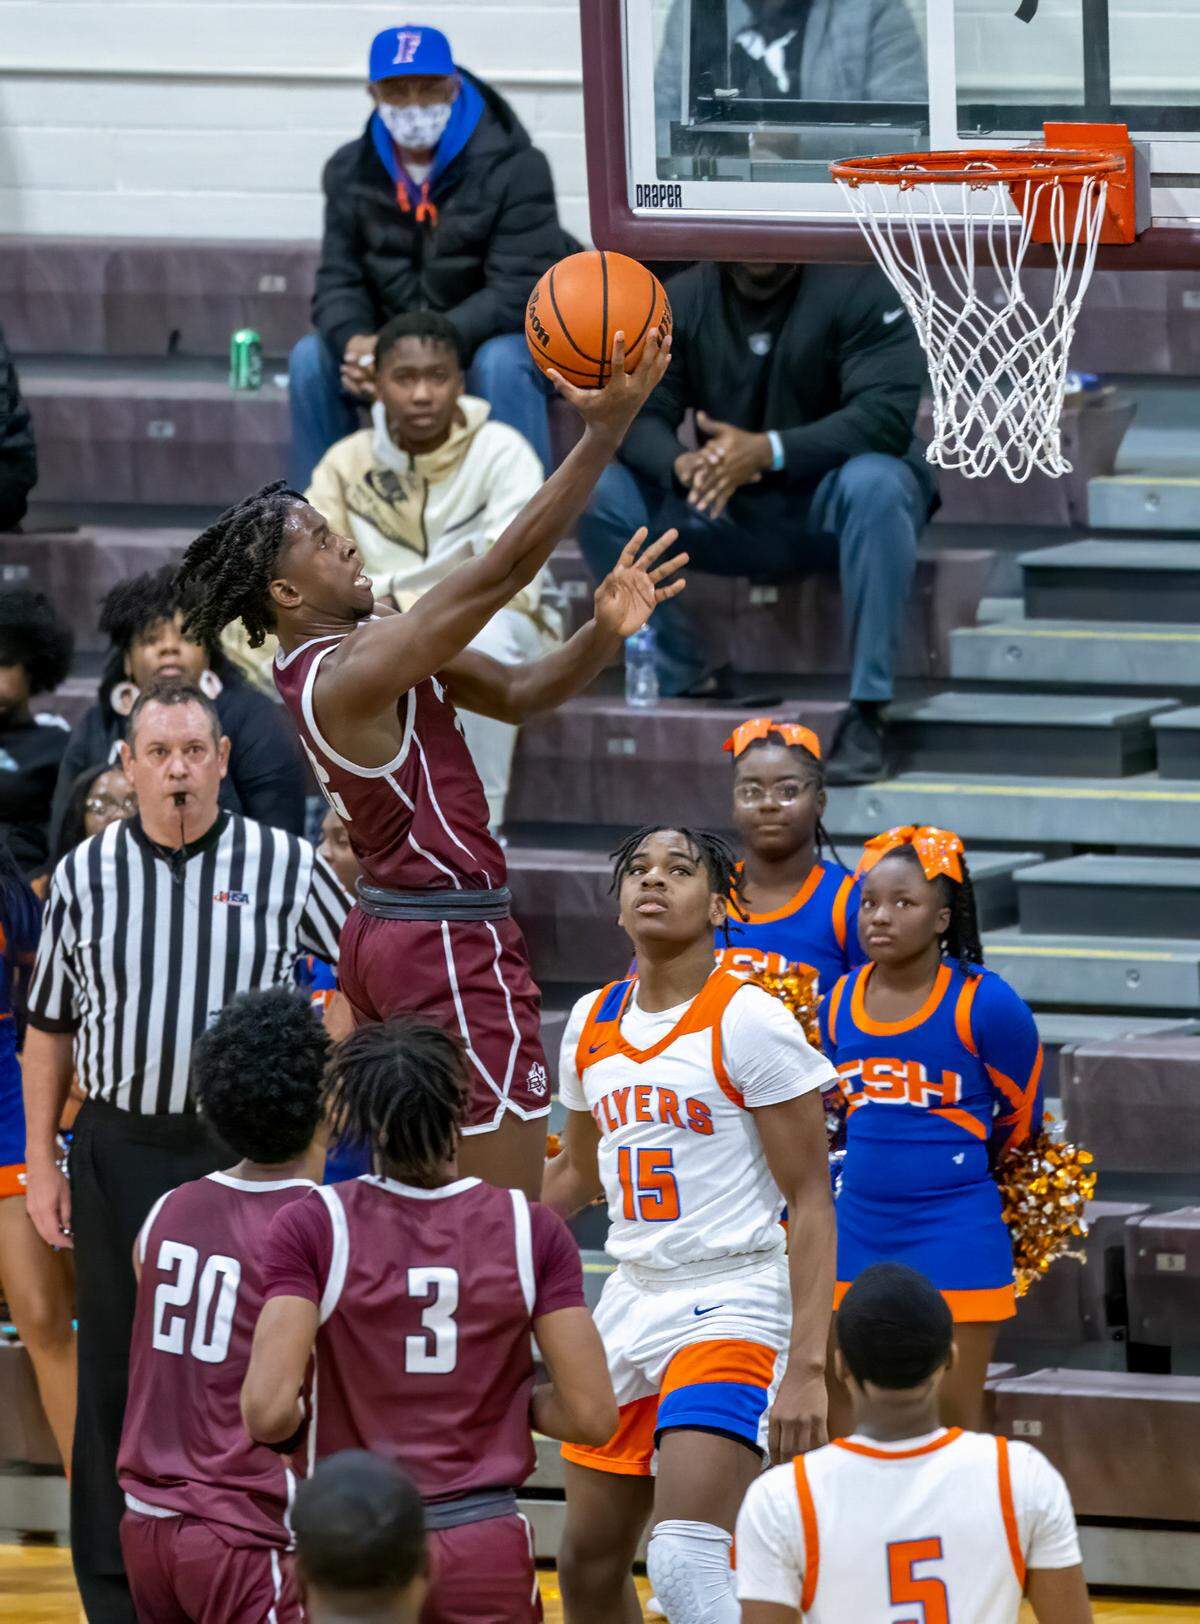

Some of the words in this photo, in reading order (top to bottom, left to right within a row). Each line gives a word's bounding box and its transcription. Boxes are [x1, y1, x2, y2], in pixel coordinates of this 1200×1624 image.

[392, 31, 421, 64] F
[617, 1146, 681, 1222] 15
[152, 1239, 241, 1363] 20
[405, 1266, 459, 1374] 3
[886, 1536, 951, 1624] 5
